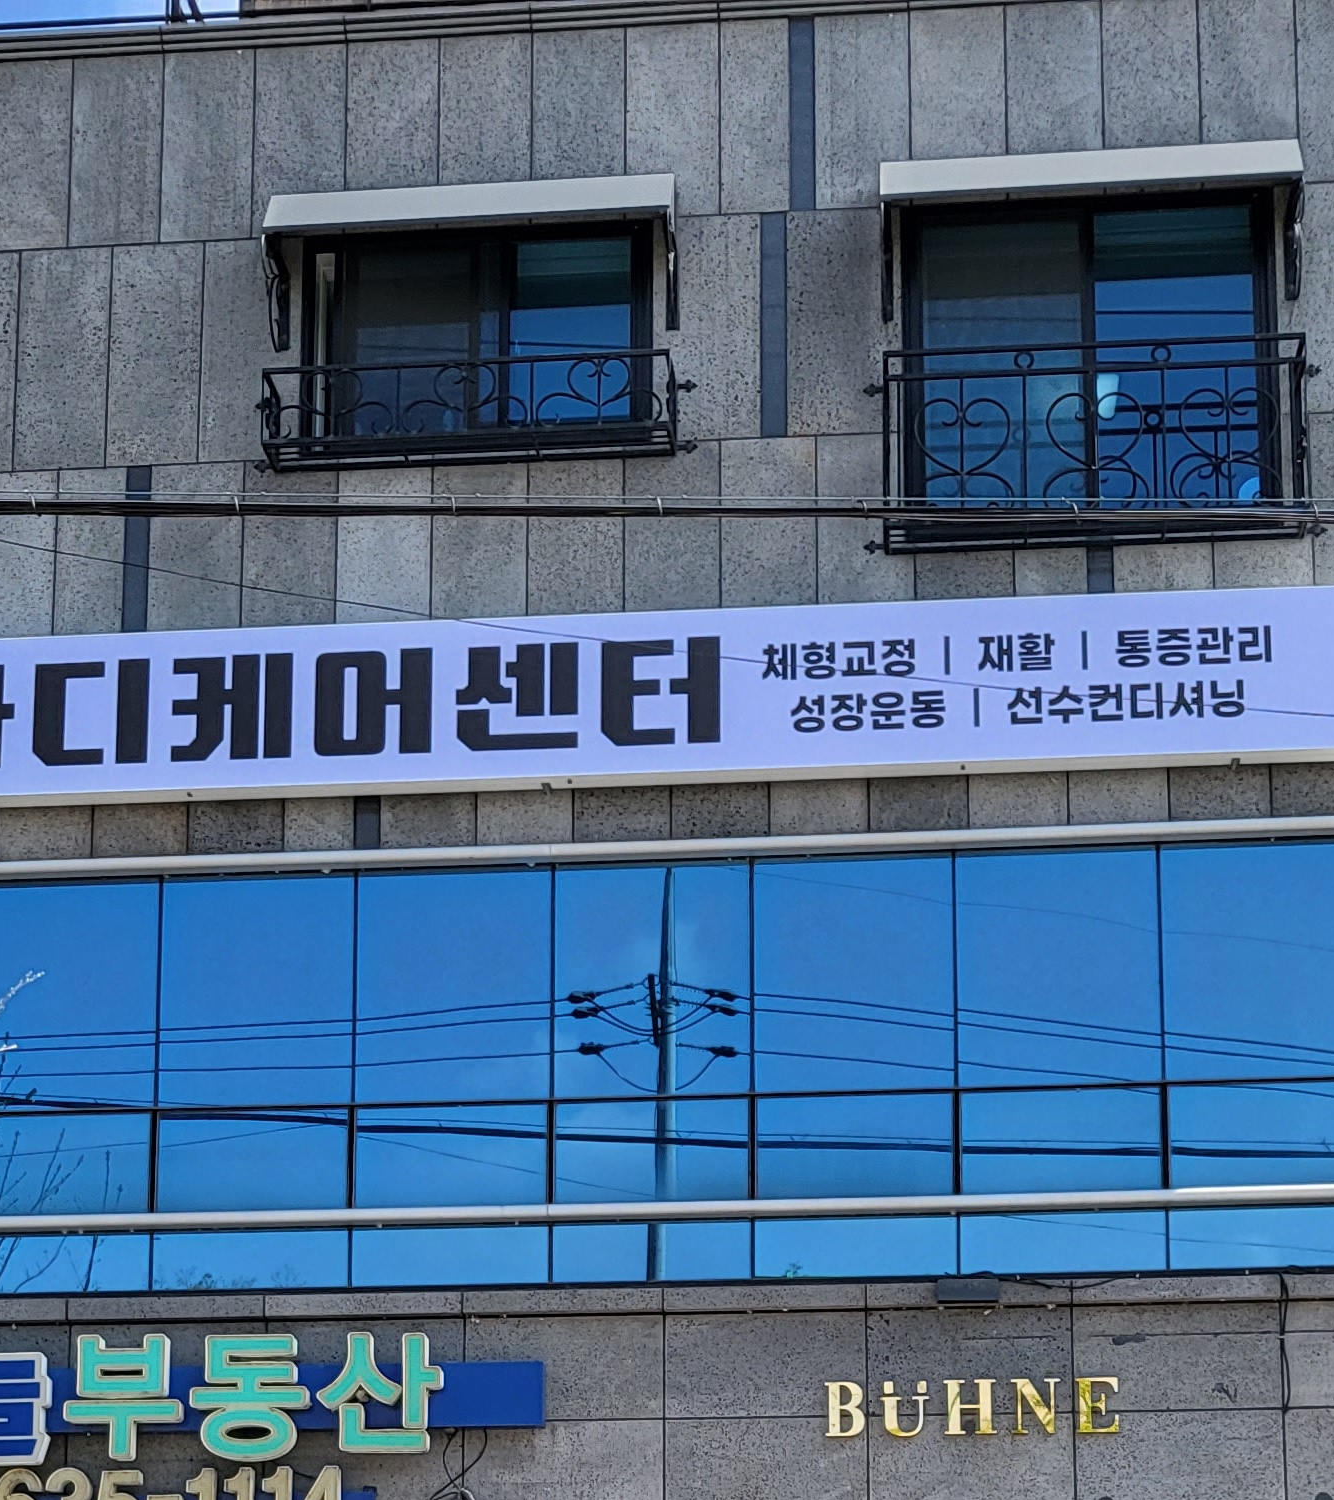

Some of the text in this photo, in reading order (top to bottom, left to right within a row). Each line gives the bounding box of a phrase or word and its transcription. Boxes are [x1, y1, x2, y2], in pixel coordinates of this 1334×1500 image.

[762, 625, 1274, 681] 체형교정 재활 통증관리
[789, 680, 1247, 734] 성장운동 선수컨디셔닝
